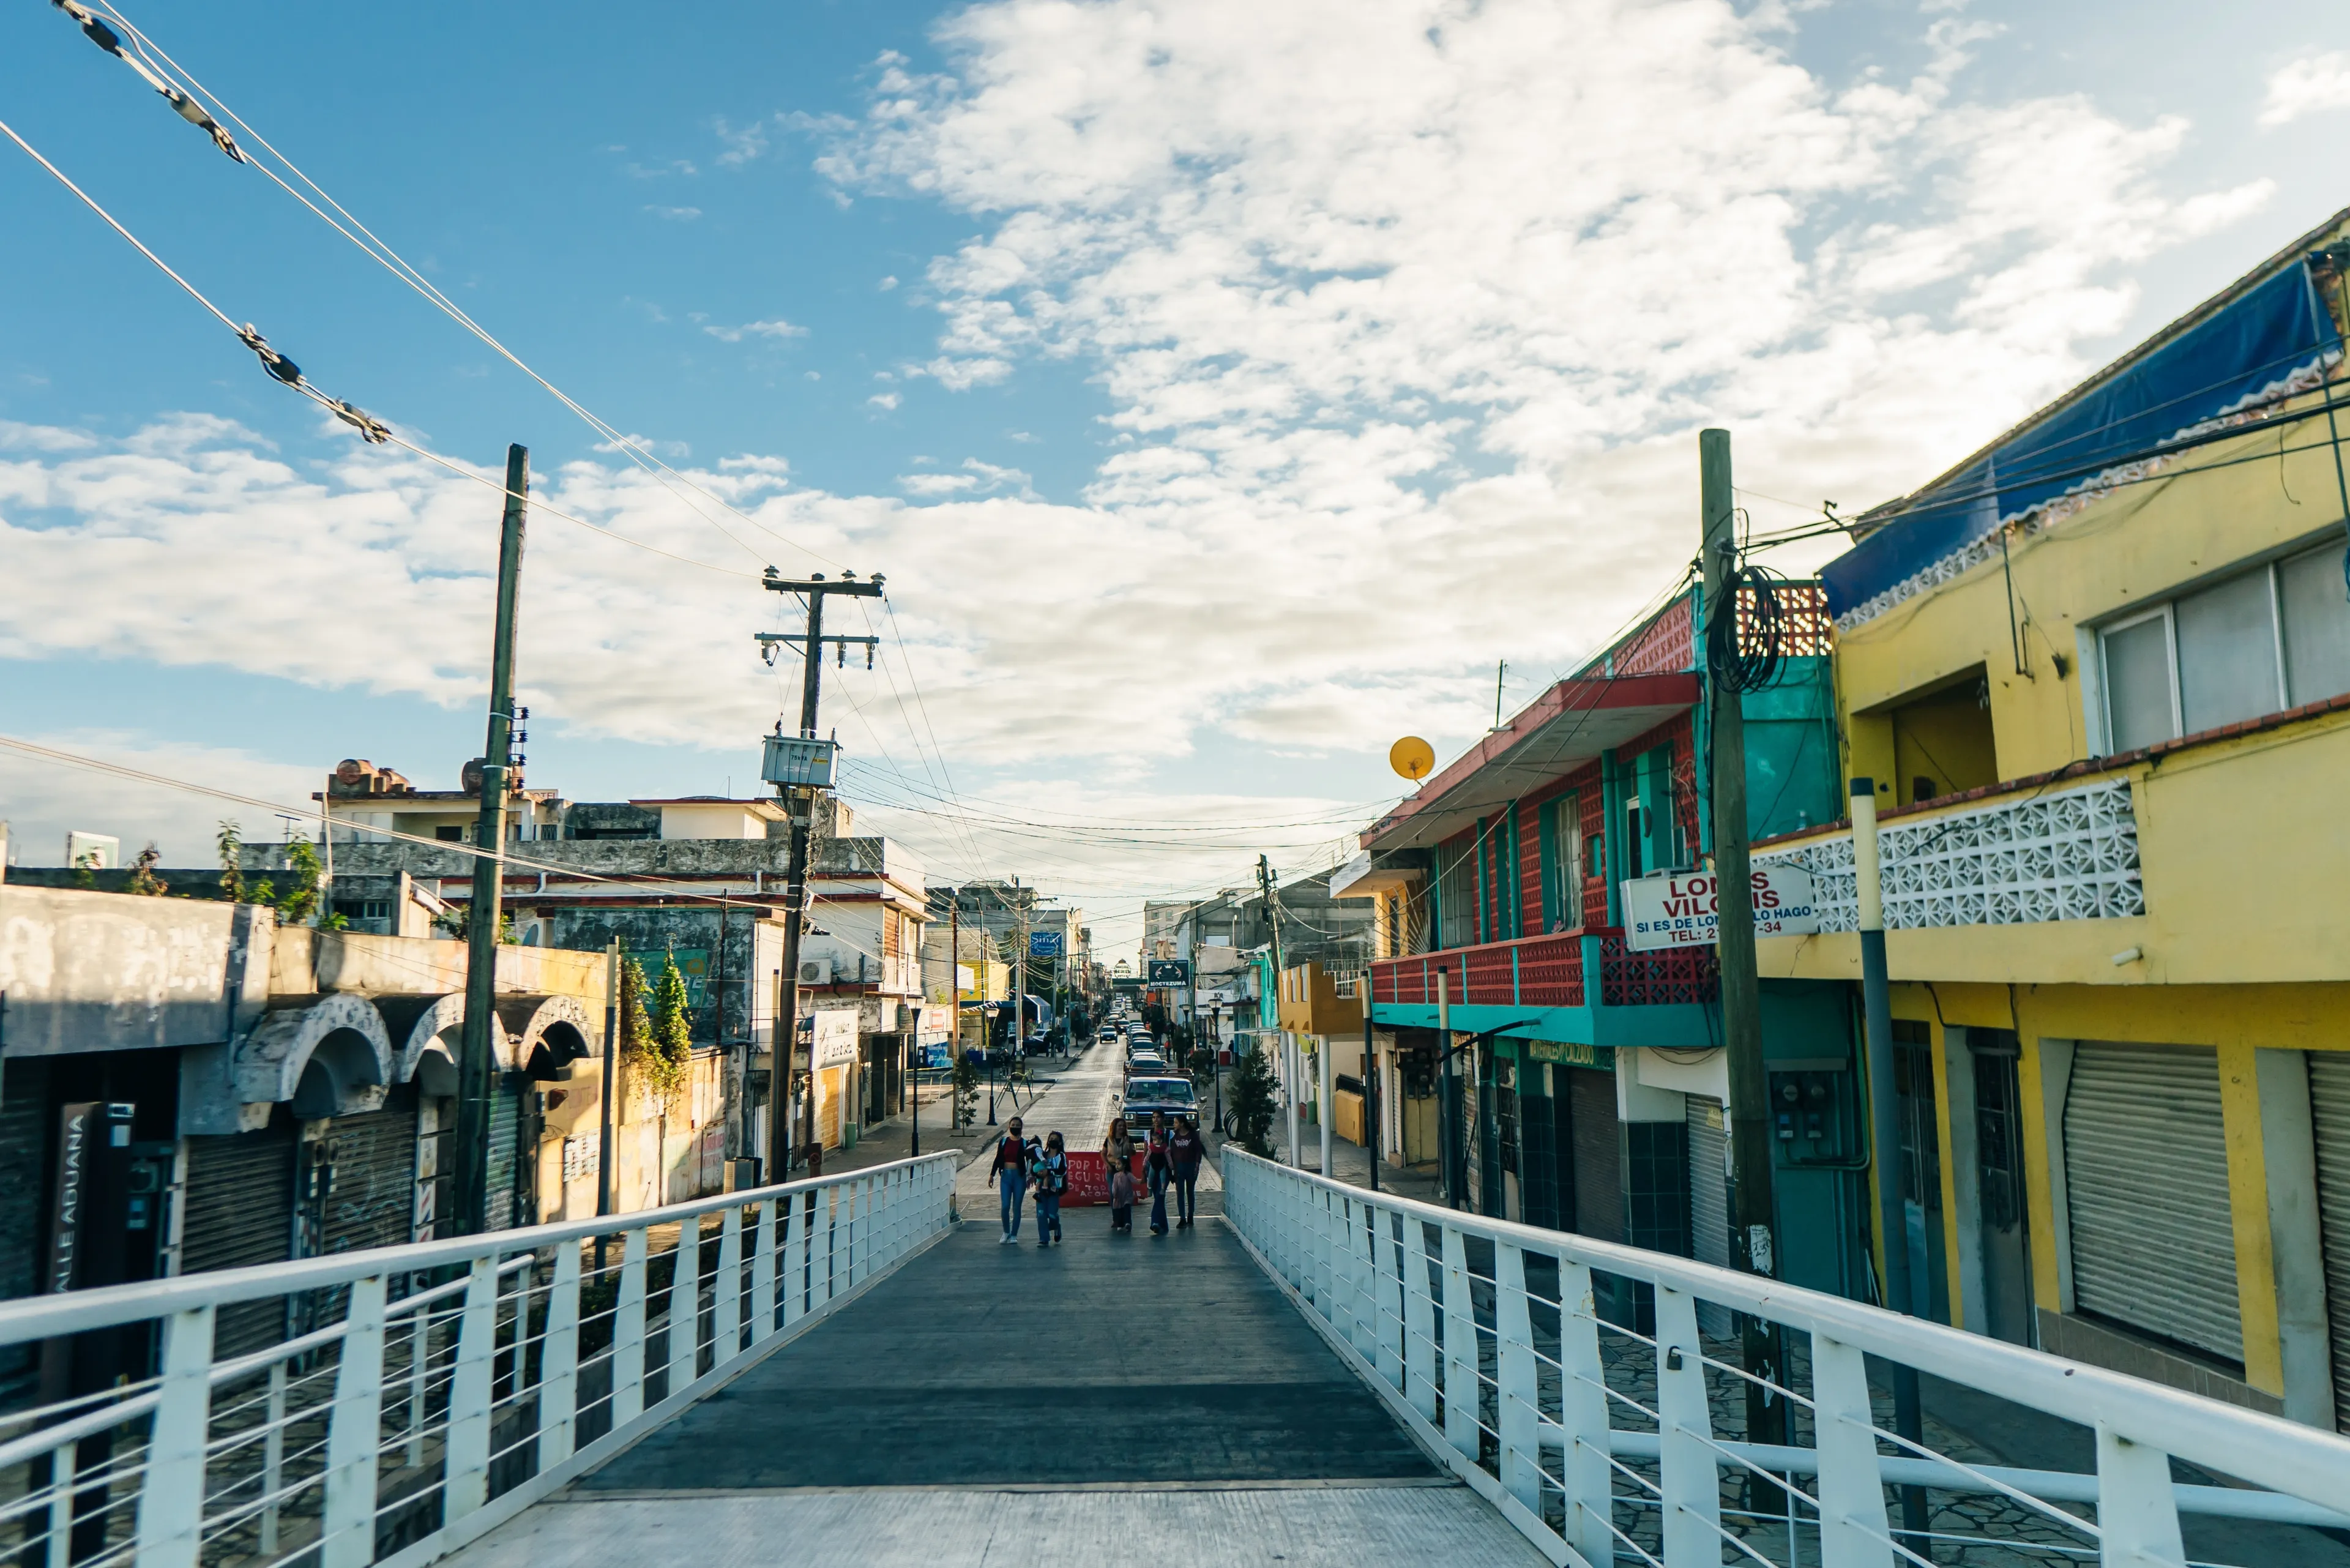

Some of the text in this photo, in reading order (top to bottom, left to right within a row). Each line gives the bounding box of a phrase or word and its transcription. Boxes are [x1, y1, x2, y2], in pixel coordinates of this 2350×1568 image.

[1669, 872, 1769, 898] LOS
[1662, 890, 1780, 918] VILIS
[1636, 906, 1811, 933] SI ES DE LO LO HAGO
[1669, 930, 1701, 943] TEL:
[1068, 1160, 1090, 1170] POR
[1068, 1182, 1080, 1192] DE
[55, 1114, 84, 1293] ALLE ADUANA
